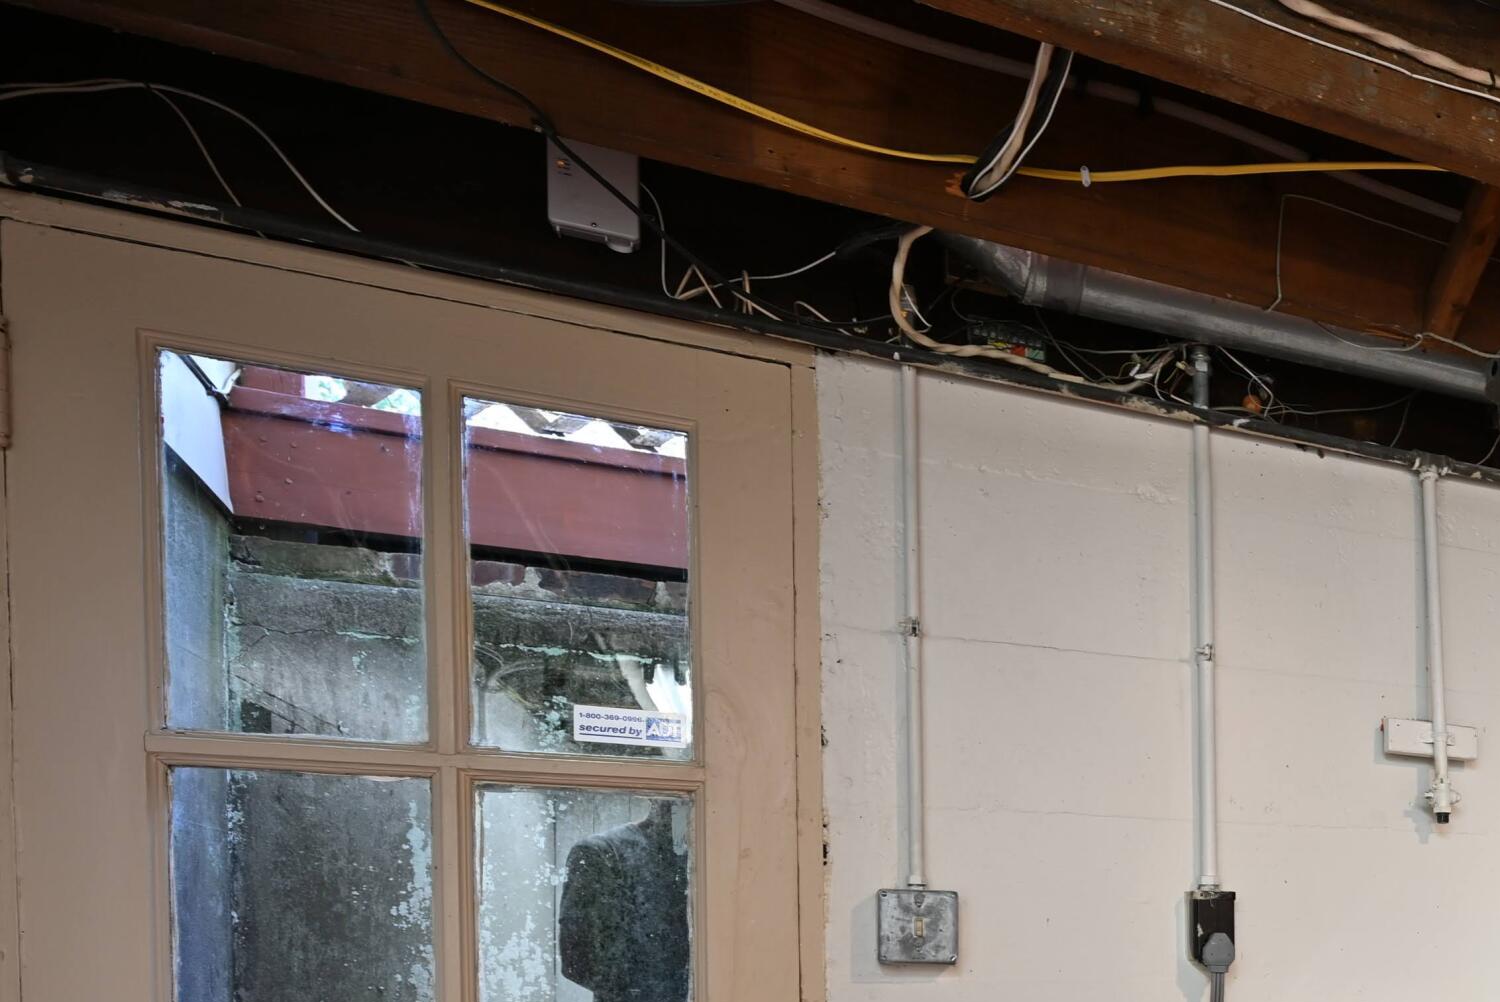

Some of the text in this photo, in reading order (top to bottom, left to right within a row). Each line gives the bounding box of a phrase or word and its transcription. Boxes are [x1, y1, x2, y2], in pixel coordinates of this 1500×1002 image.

[579, 724, 642, 737] secured by
[647, 721, 680, 737] ADT
